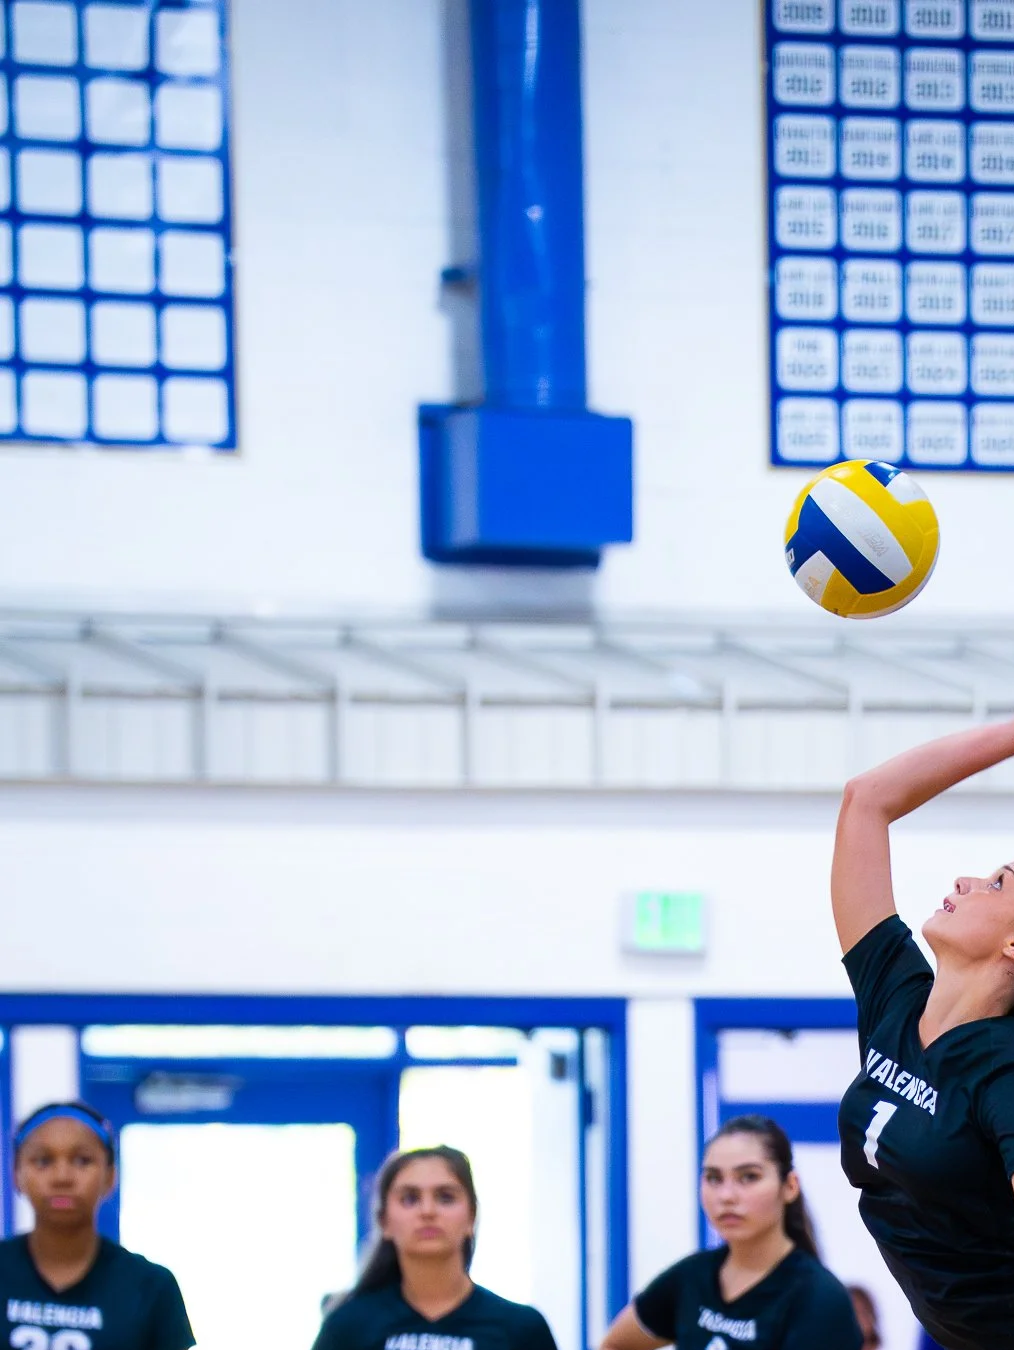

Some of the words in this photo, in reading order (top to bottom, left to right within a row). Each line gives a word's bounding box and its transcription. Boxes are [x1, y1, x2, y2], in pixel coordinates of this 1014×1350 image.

[867, 1048, 938, 1115] VALENCIA
[863, 1100, 898, 1170] 1
[8, 1299, 103, 1330] VALENCIA
